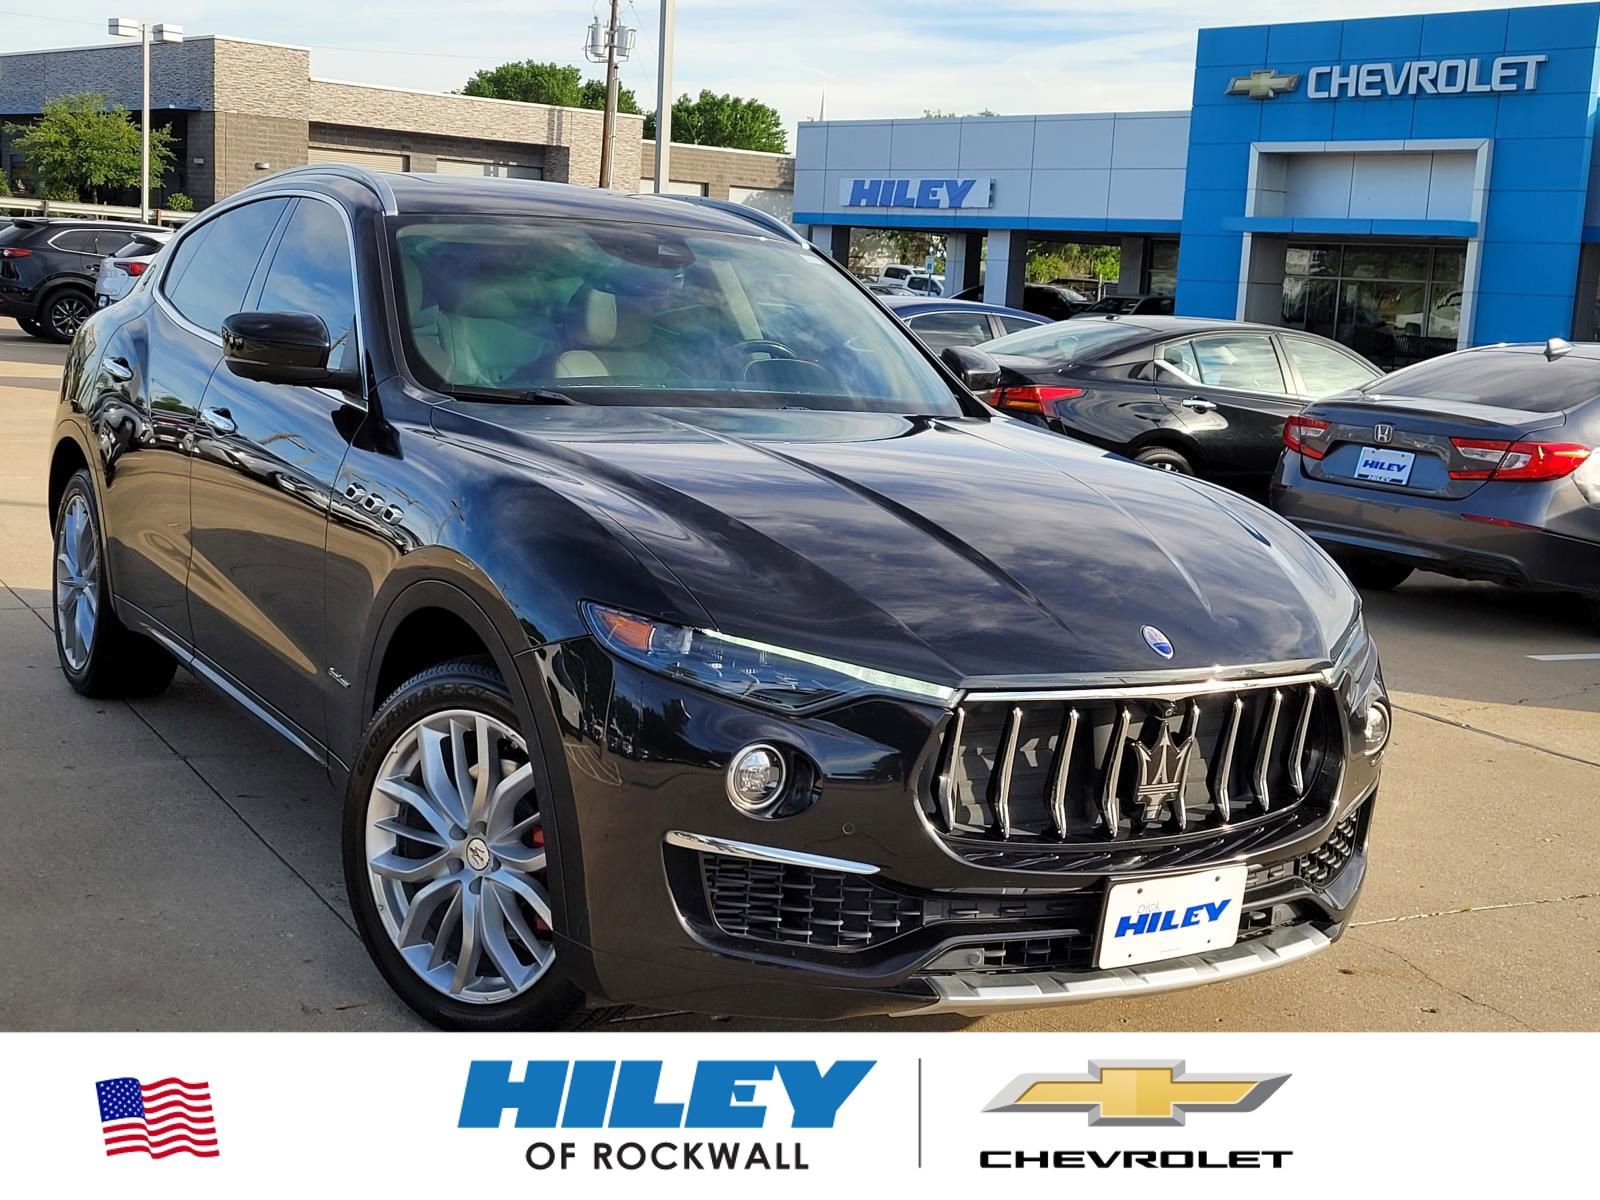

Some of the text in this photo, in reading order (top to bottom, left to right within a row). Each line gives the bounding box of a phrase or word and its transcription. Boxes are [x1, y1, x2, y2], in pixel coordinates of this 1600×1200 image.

[1307, 54, 1548, 99] CHEVROLET
[848, 179, 977, 208] HILEY
[1362, 459, 1407, 472] HILEY
[1115, 899, 1232, 938] HILEY
